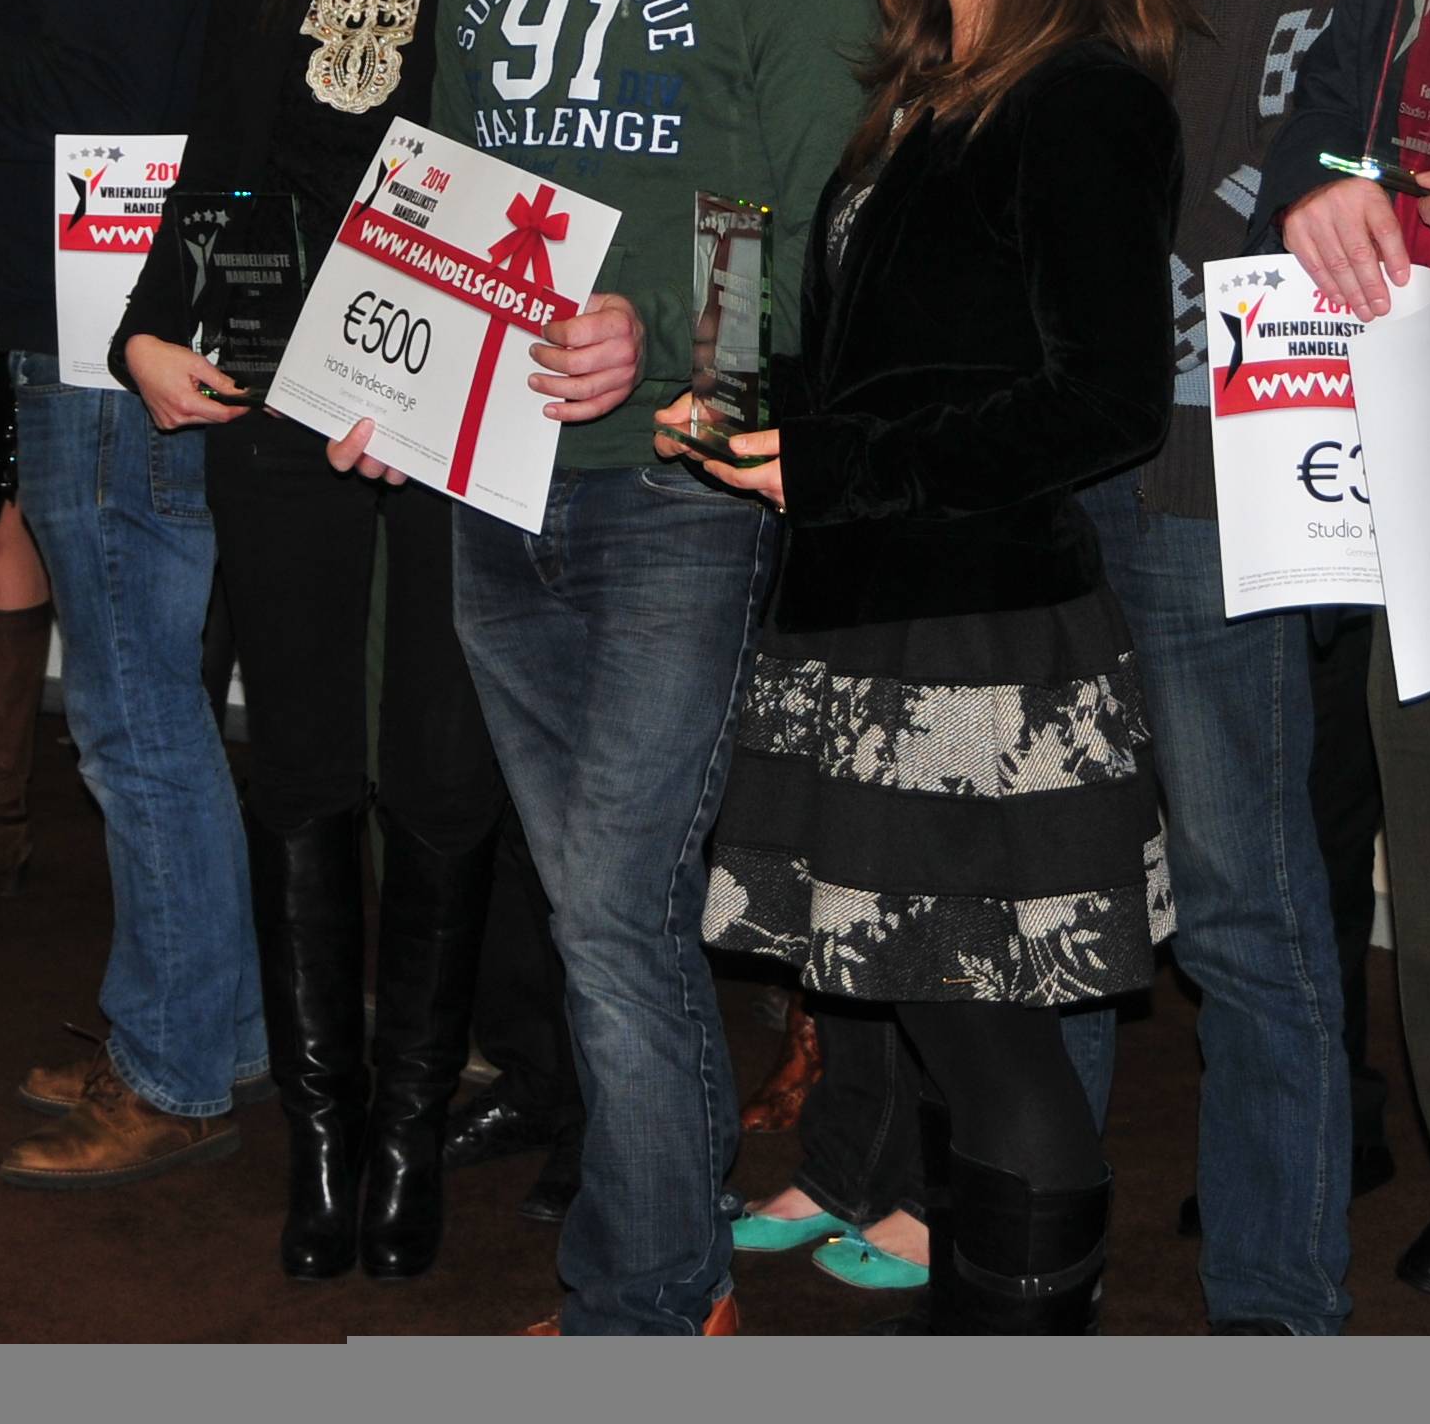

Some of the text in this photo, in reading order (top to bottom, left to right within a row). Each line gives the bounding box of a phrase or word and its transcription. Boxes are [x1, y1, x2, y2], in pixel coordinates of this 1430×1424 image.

[1398, 102, 1426, 120] Studio
[145, 162, 179, 181] 201
[420, 165, 451, 194] 2014
[387, 180, 439, 214] VRIENDELIJKSTE
[392, 202, 430, 230] HANDELAAR
[359, 219, 555, 326] WWW.HANDELSGIDS.BE
[343, 290, 431, 375] €500
[1257, 321, 1365, 338] VRIENDELIJKSTE
[324, 355, 349, 378] Horta
[351, 365, 417, 412] Vandecaveye
[1307, 518, 1362, 539] Studio
